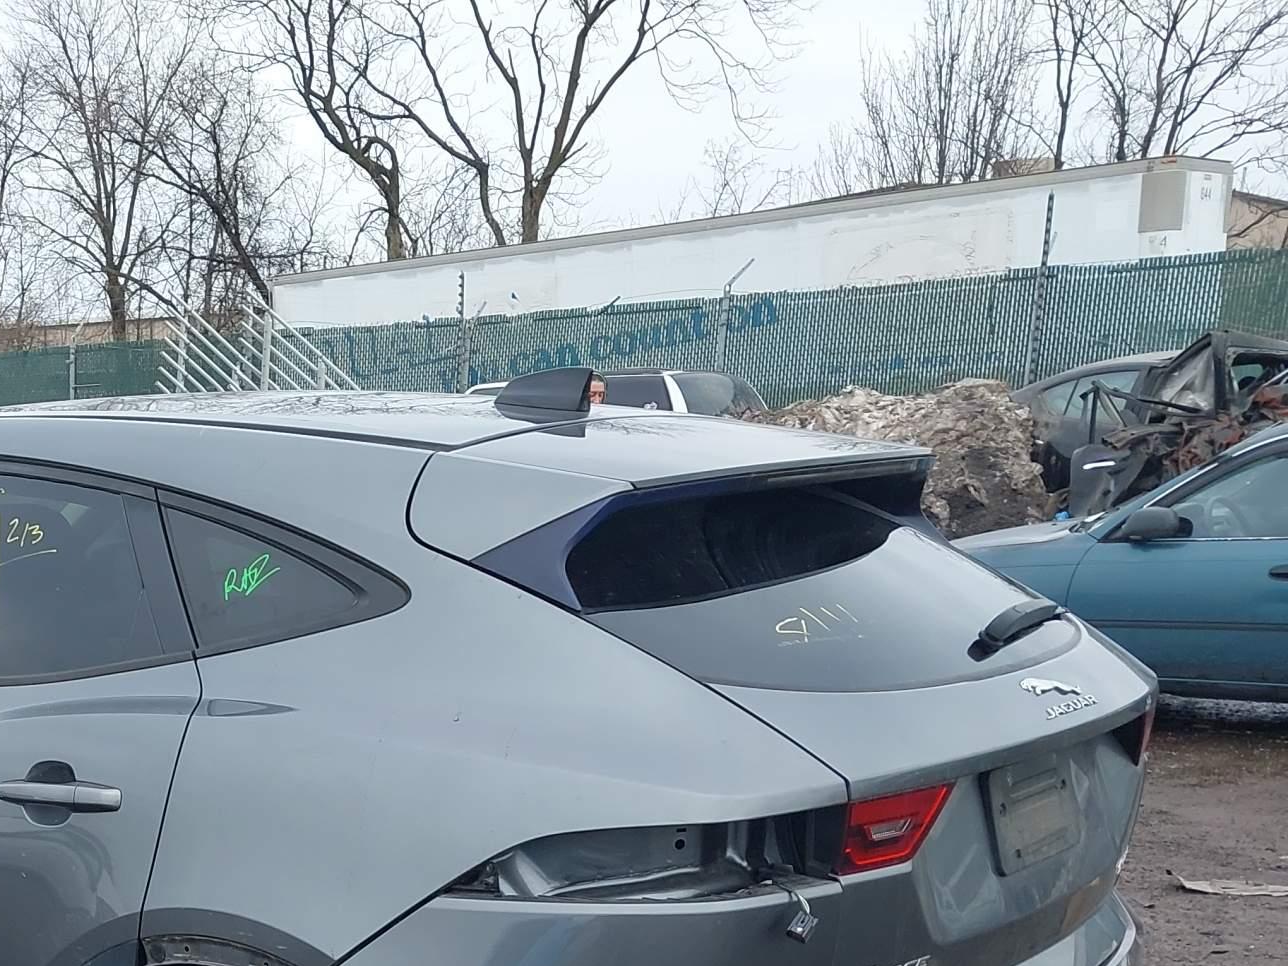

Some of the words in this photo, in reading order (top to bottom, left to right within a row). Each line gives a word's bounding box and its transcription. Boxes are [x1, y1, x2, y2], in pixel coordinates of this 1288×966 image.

[590, 306, 709, 360] count
[727, 297, 778, 333] on
[6, 517, 44, 547] 2/3
[1046, 694, 1099, 720] JAGUAR
